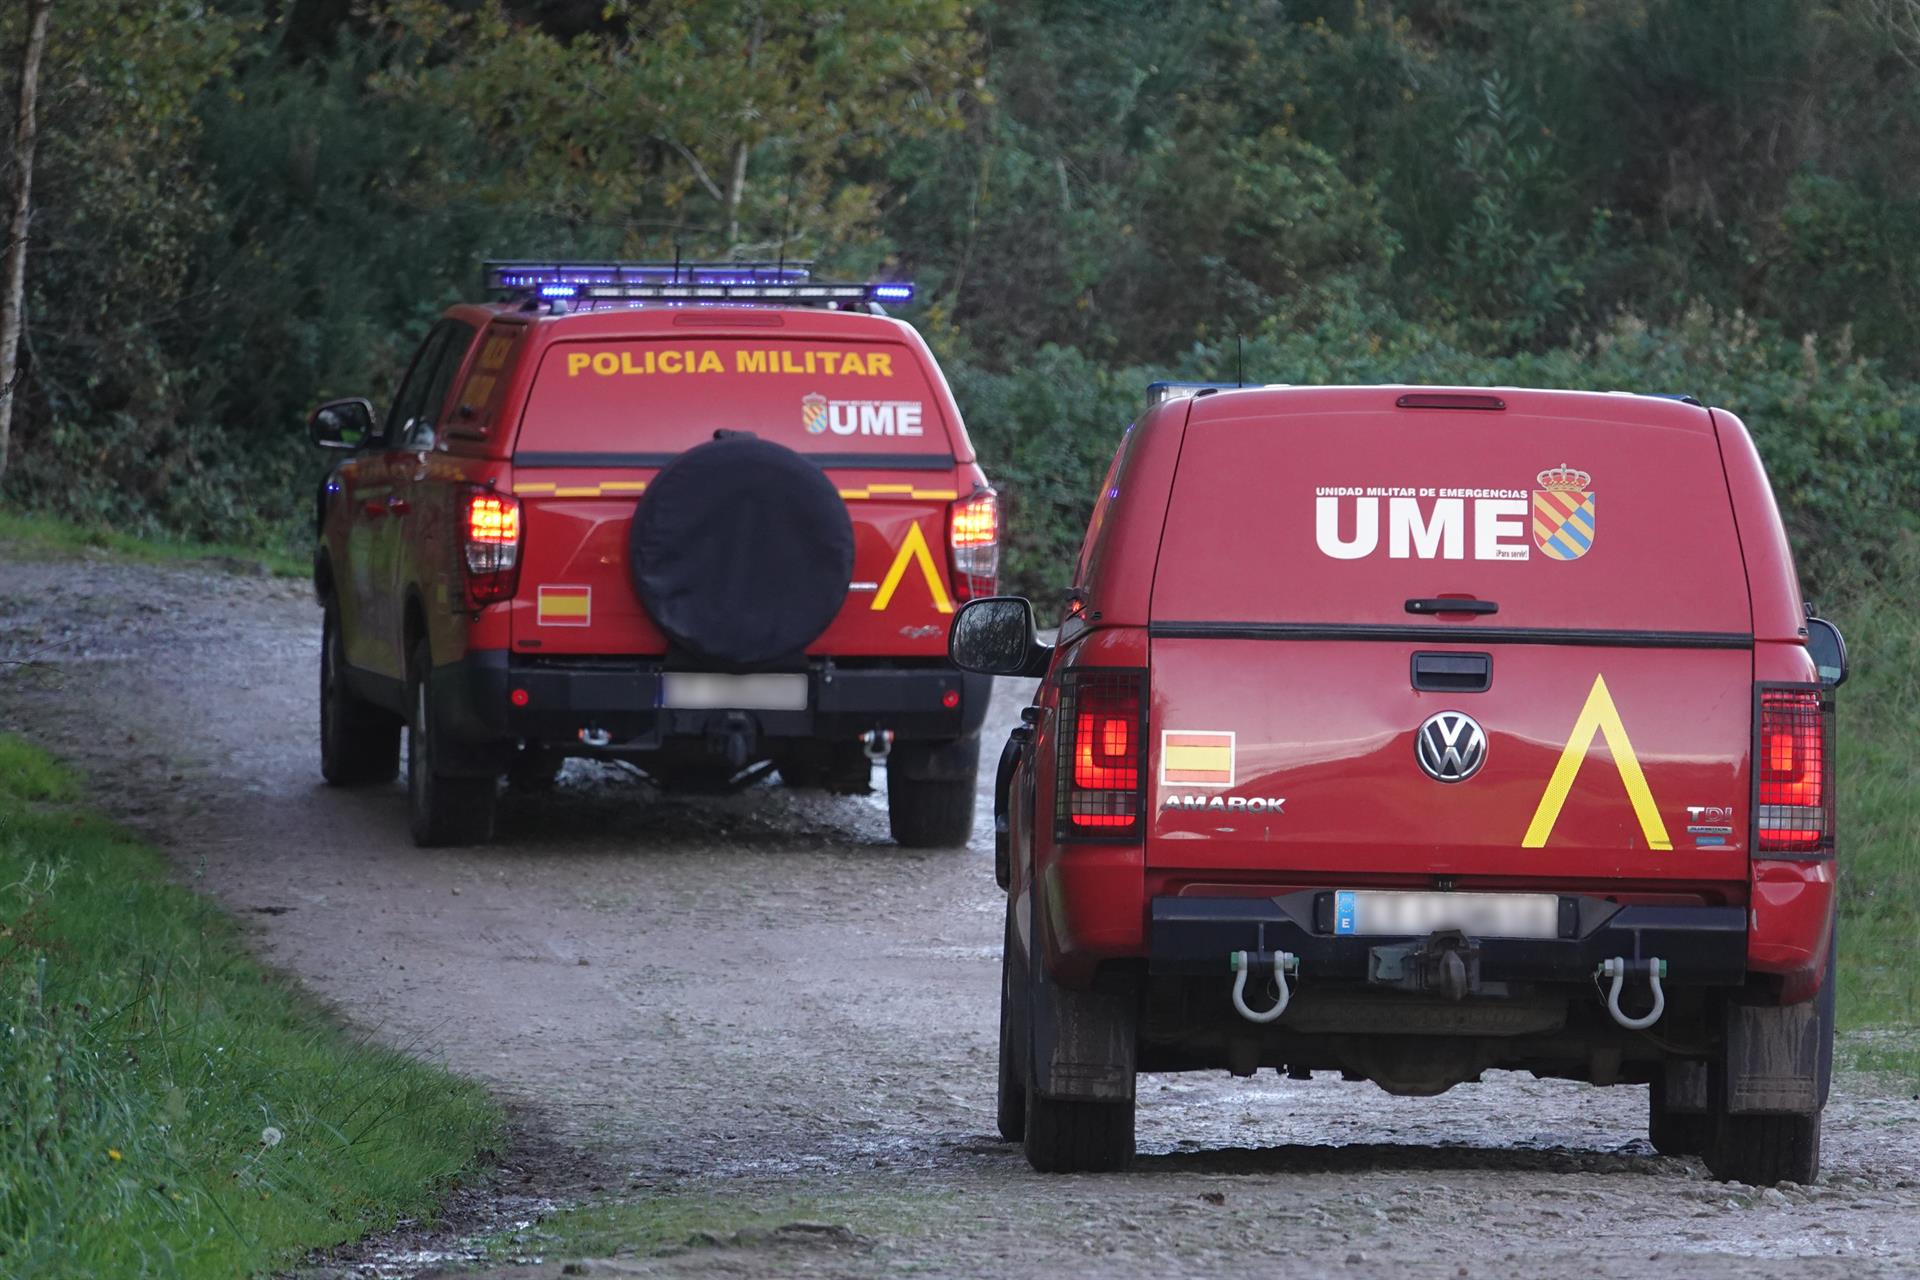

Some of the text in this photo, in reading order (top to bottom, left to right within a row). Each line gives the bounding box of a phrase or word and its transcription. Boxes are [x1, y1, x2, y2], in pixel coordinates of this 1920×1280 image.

[568, 350, 893, 376] POLICIA MILITAR
[829, 405, 923, 436] UME
[1316, 487, 1528, 499] UNIDAD MILITAR DE EMERGENCIAS
[1316, 497, 1529, 560] UME
[1163, 795, 1287, 814] AMAROK
[1687, 806, 1733, 822] TDI
[1341, 918, 1351, 929] E
